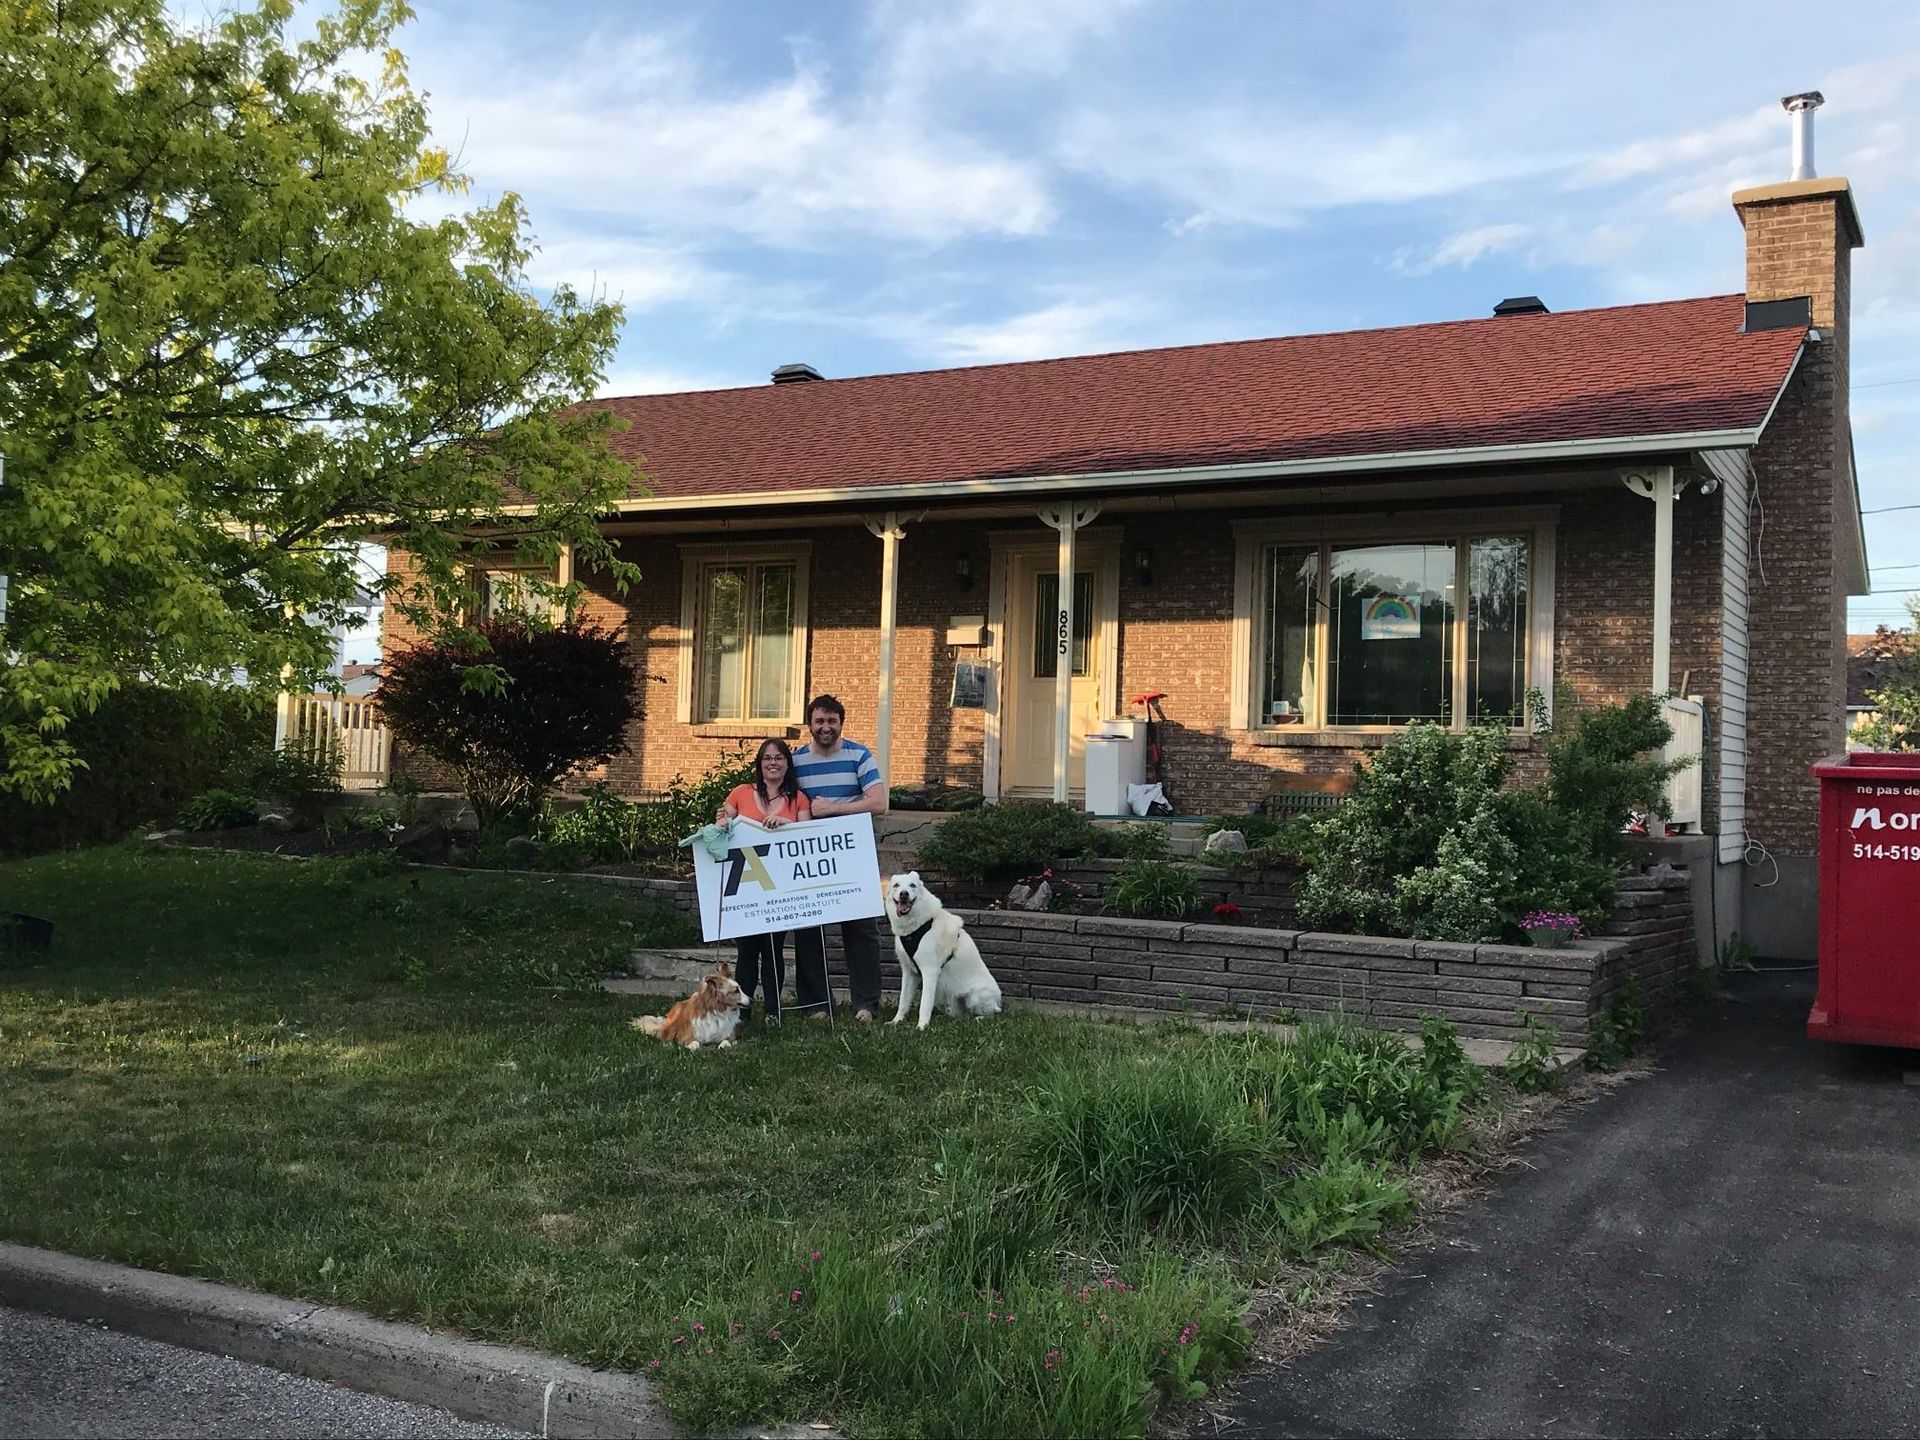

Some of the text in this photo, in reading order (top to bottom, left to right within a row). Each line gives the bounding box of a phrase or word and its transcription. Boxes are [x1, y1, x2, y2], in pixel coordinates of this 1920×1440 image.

[1060, 610, 1068, 655] 865
[1857, 786, 1873, 794] ne
[1877, 786, 1900, 796] pas
[775, 832, 856, 859] TOITURE
[1853, 843, 1920, 861] 514-519
[793, 857, 837, 880] ALOI
[744, 898, 842, 918] ESTIMATION GRATUITE
